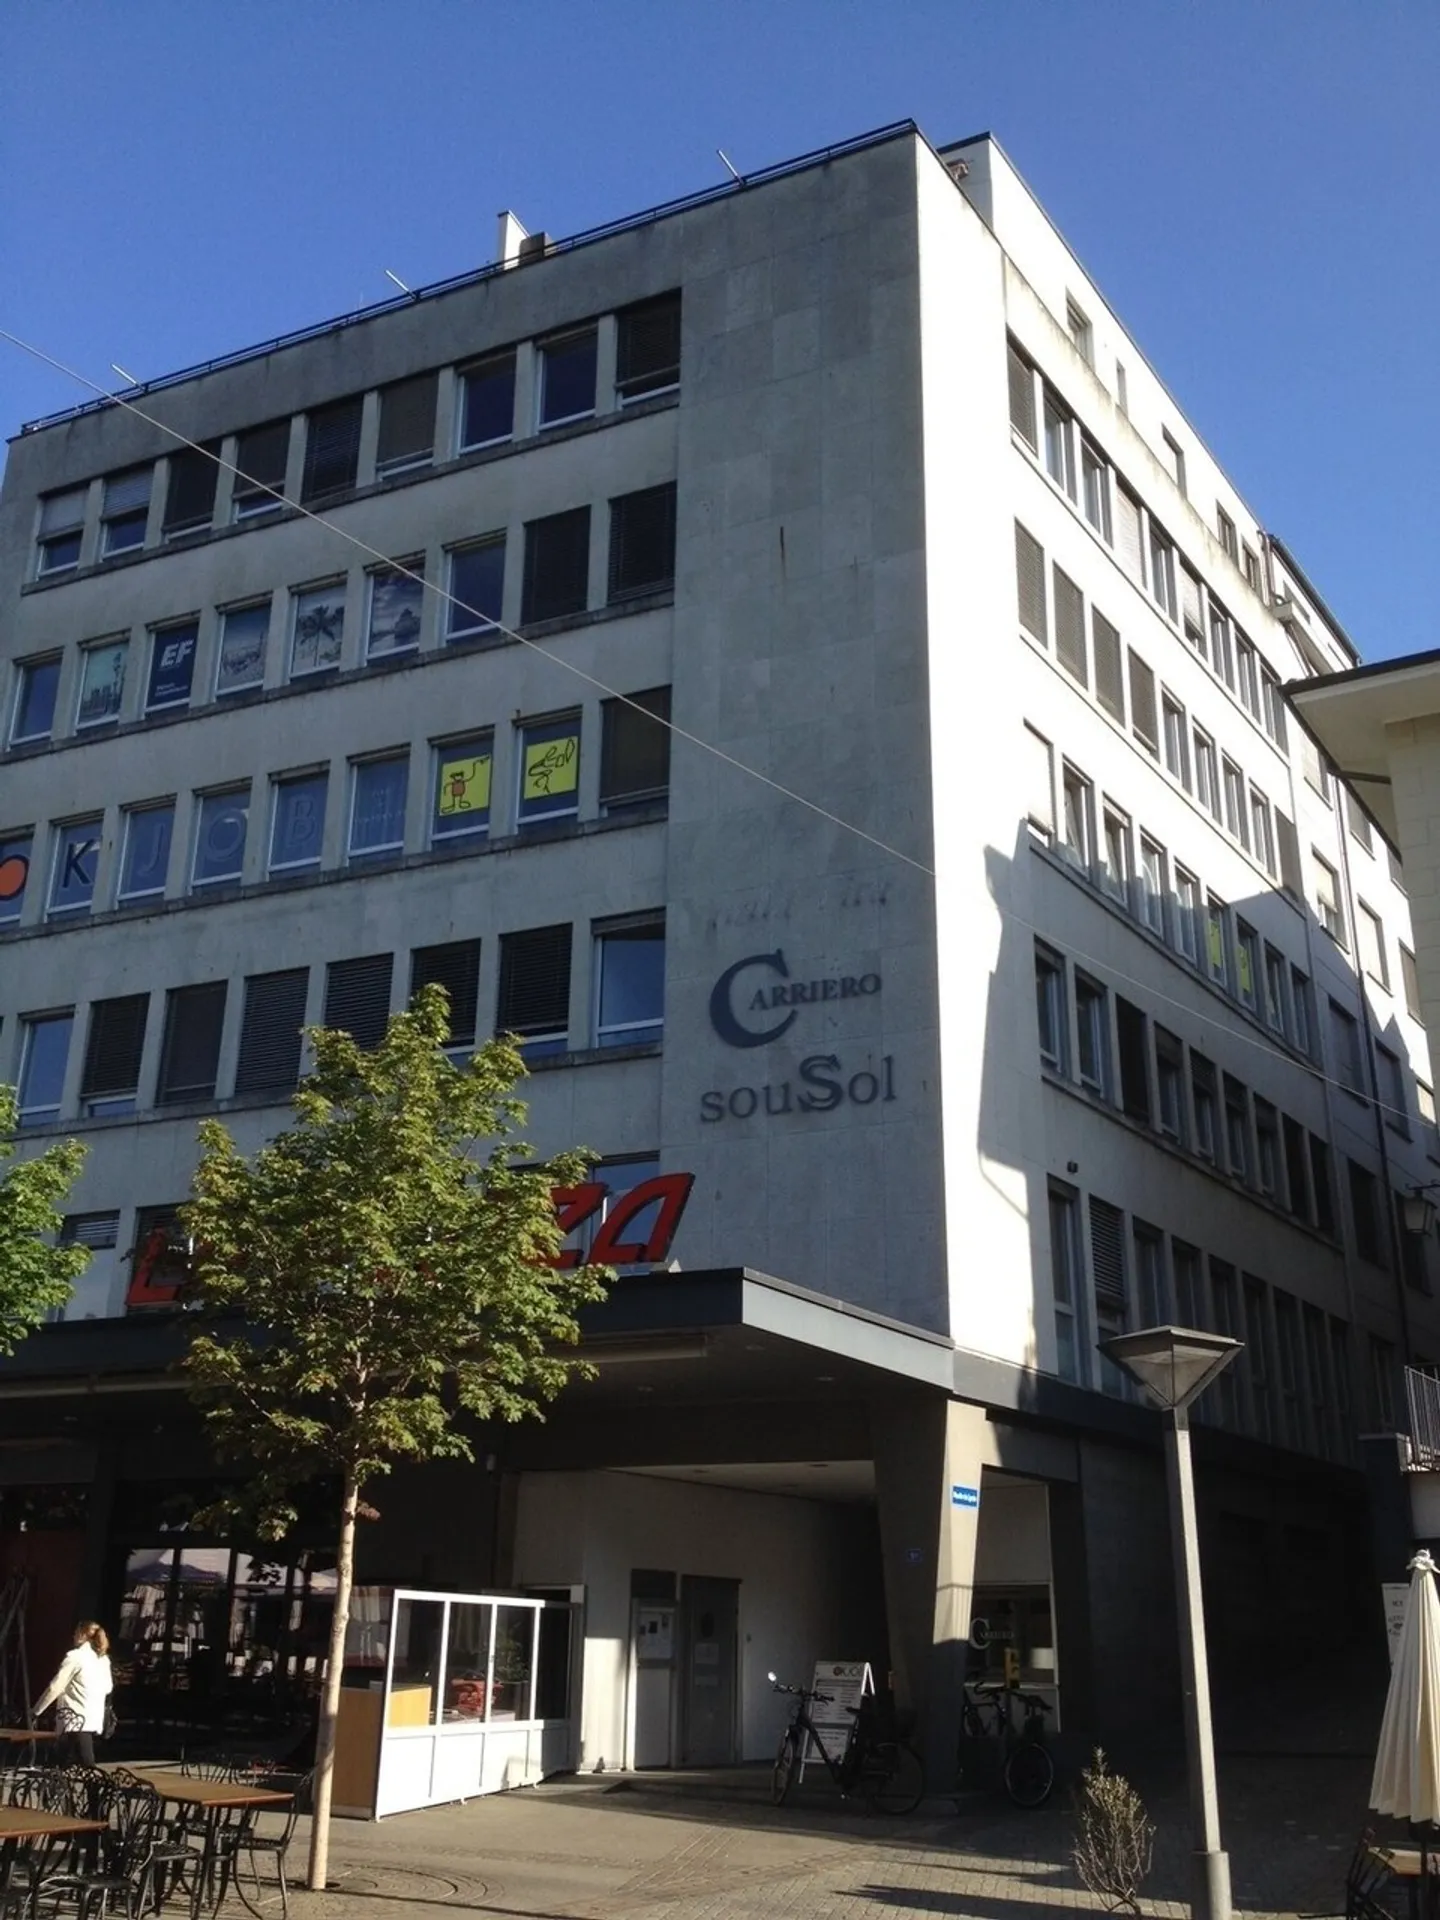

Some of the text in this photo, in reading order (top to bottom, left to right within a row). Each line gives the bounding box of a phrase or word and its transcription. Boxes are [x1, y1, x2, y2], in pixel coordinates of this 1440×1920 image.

[160, 638, 194, 668] EF
[709, 947, 883, 1049] CARRIERO
[699, 1054, 898, 1124] souSol
